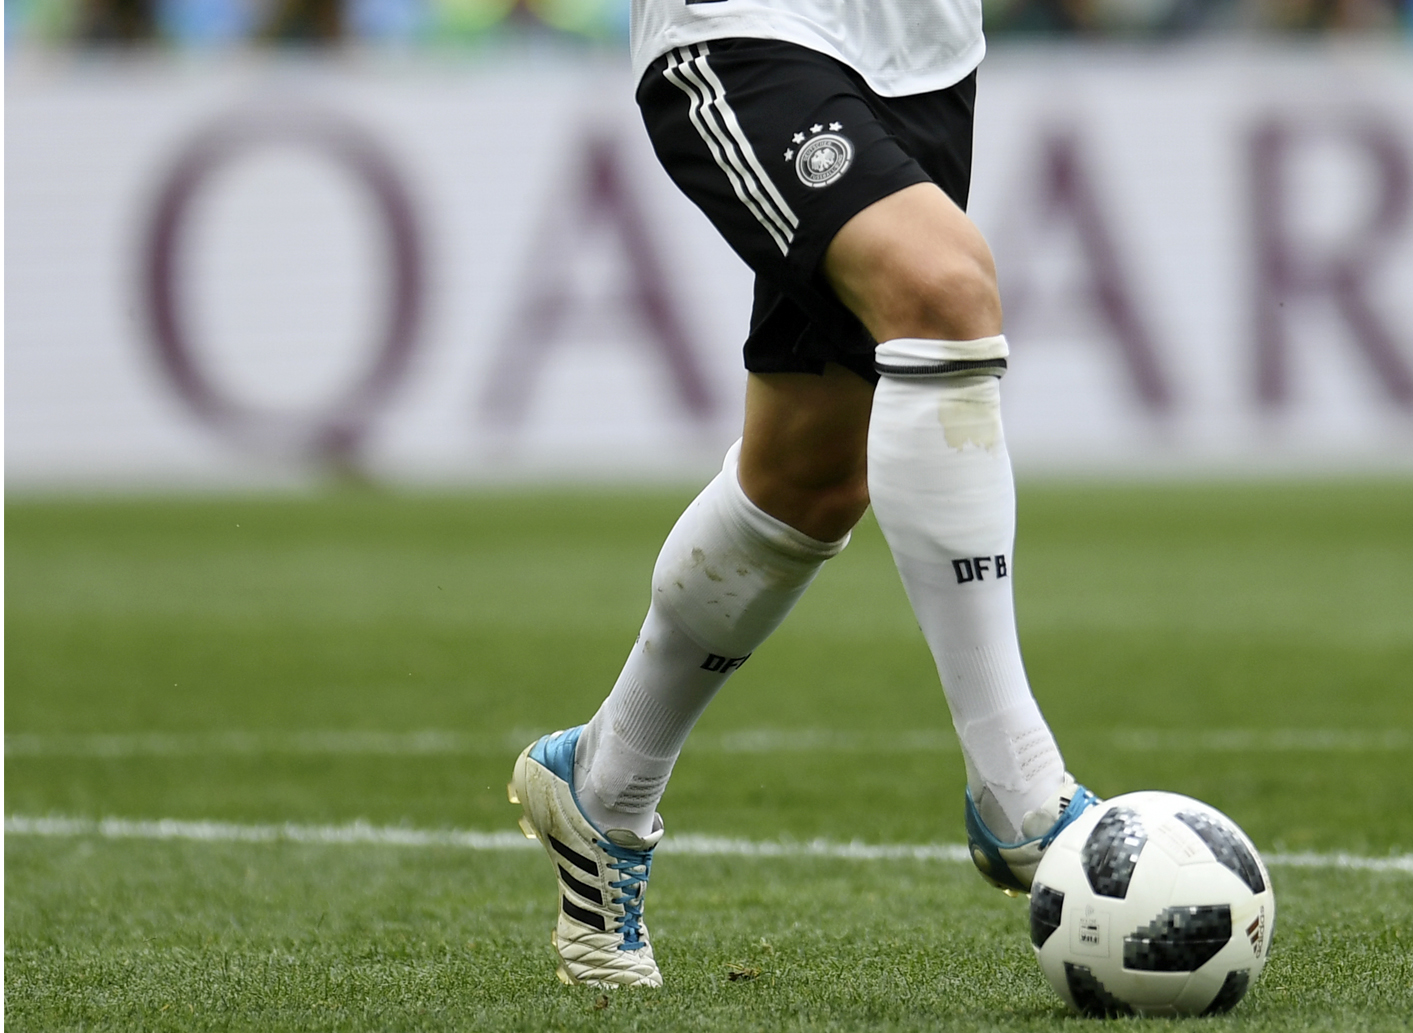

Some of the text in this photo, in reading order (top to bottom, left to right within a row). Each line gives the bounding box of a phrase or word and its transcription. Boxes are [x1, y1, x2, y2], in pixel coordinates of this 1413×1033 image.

[140, 103, 1413, 463] QAAR
[951, 554, 1008, 584] DFB
[700, 652, 752, 674] DF
